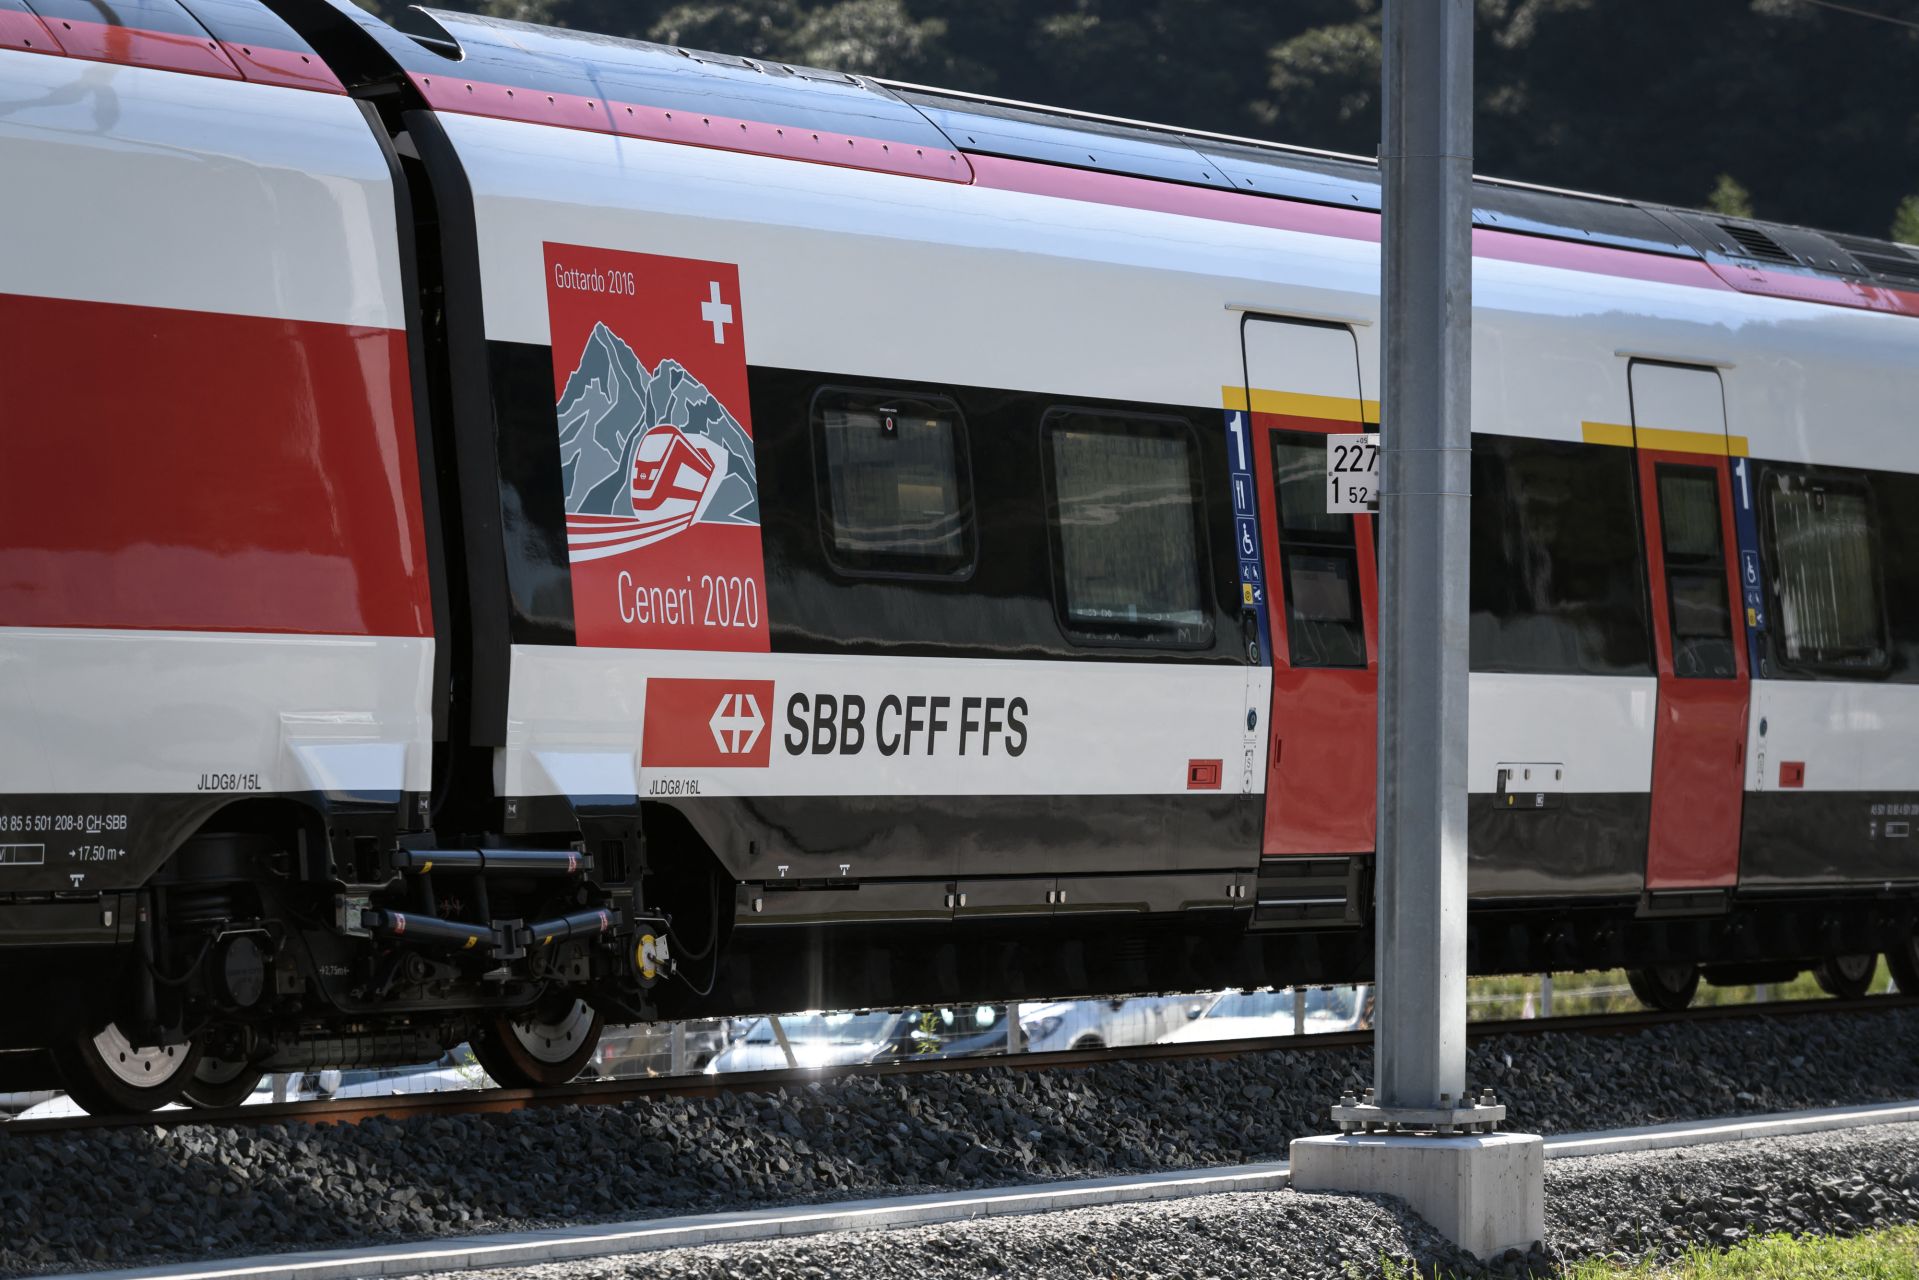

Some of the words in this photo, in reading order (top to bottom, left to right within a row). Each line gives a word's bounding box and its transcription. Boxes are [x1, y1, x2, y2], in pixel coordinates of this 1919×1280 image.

[555, 263, 605, 293] Gottardo
[607, 270, 635, 296] 2016
[1229, 411, 1246, 470] 1
[1334, 445, 1377, 472] 227
[1332, 476, 1339, 504] 1
[1349, 487, 1368, 504] 52
[1736, 458, 1749, 509] 1
[618, 570, 694, 625] Ceneri
[701, 575, 759, 628] 2020
[784, 692, 866, 756] SBB
[876, 694, 951, 757] CFF
[958, 696, 1029, 758] FFS
[197, 773, 262, 790] JLDG8/15L
[649, 779, 701, 796] JLDG8/16L
[0, 815, 8, 831] 3
[10, 815, 23, 831] 85
[25, 815, 32, 831] 5
[34, 815, 52, 831] 501
[54, 814, 84, 831] 208-8
[86, 814, 128, 832] CH-SBB
[78, 846, 105, 861] 17.50
